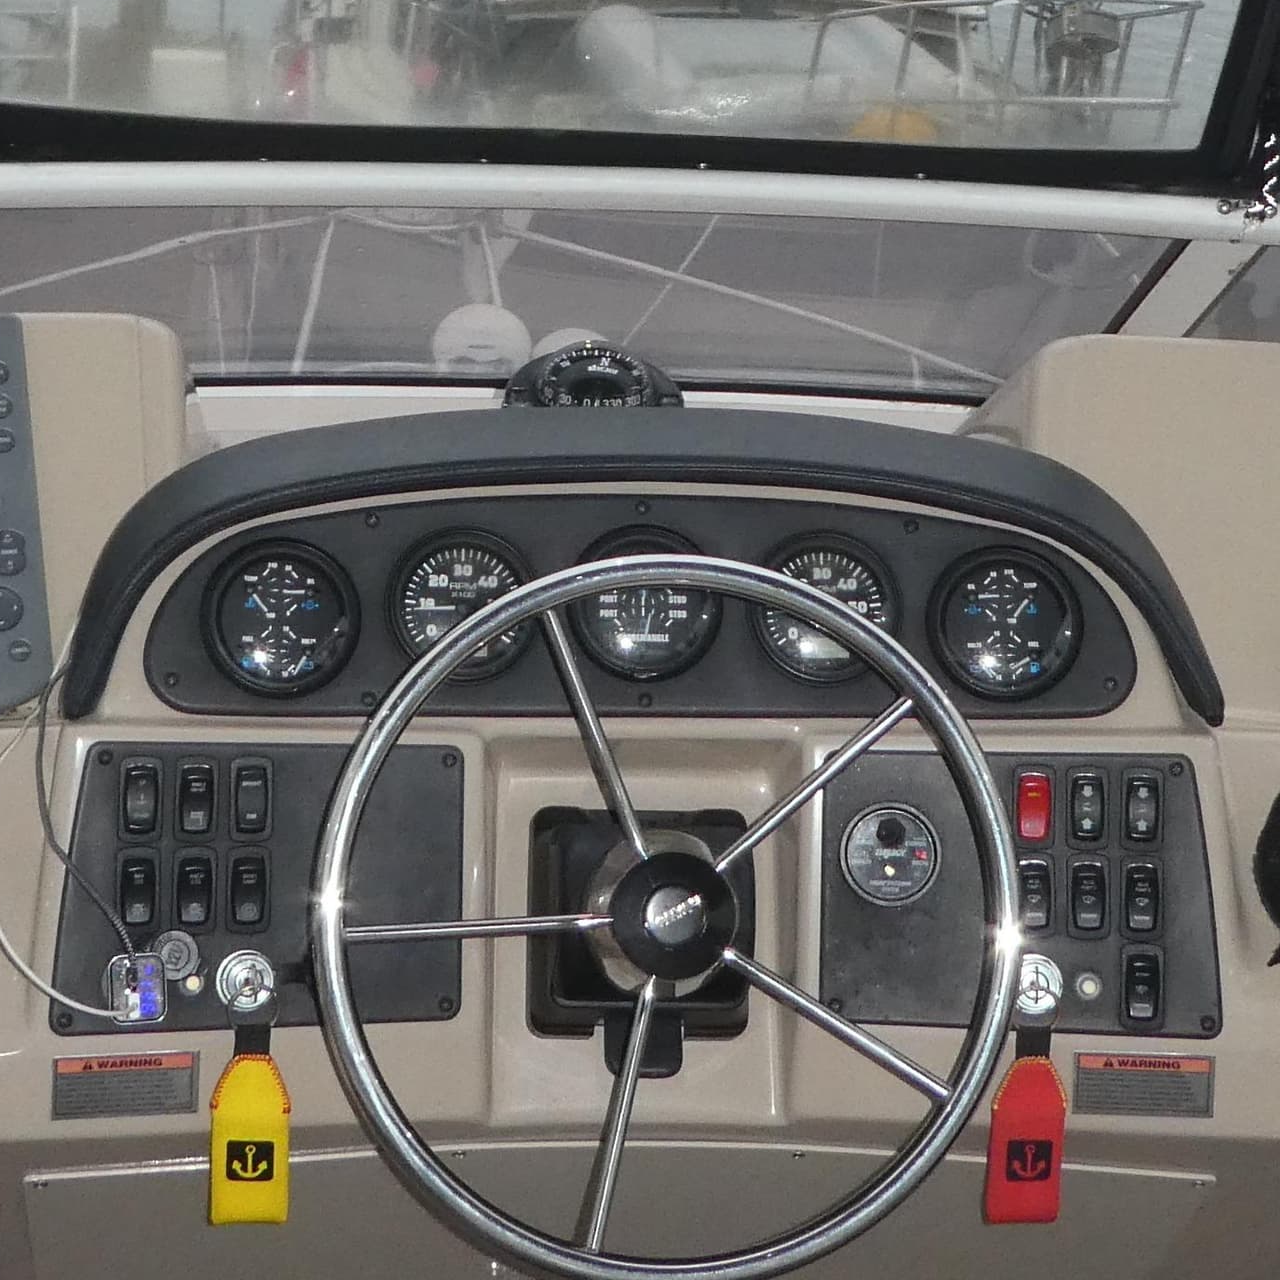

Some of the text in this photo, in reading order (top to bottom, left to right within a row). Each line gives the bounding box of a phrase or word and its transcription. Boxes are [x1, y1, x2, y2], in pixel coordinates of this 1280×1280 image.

[453, 564, 472, 576] 30
[428, 574, 448, 587] 20
[478, 575, 498, 588] 40
[837, 578, 857, 590] 40
[600, 595, 618, 603] PORT
[600, 609, 618, 617] PORT
[426, 624, 437, 636] 0
[788, 627, 798, 639] 0
[97, 1058, 163, 1069] WARNING
[1117, 1058, 1181, 1070] WARNING
